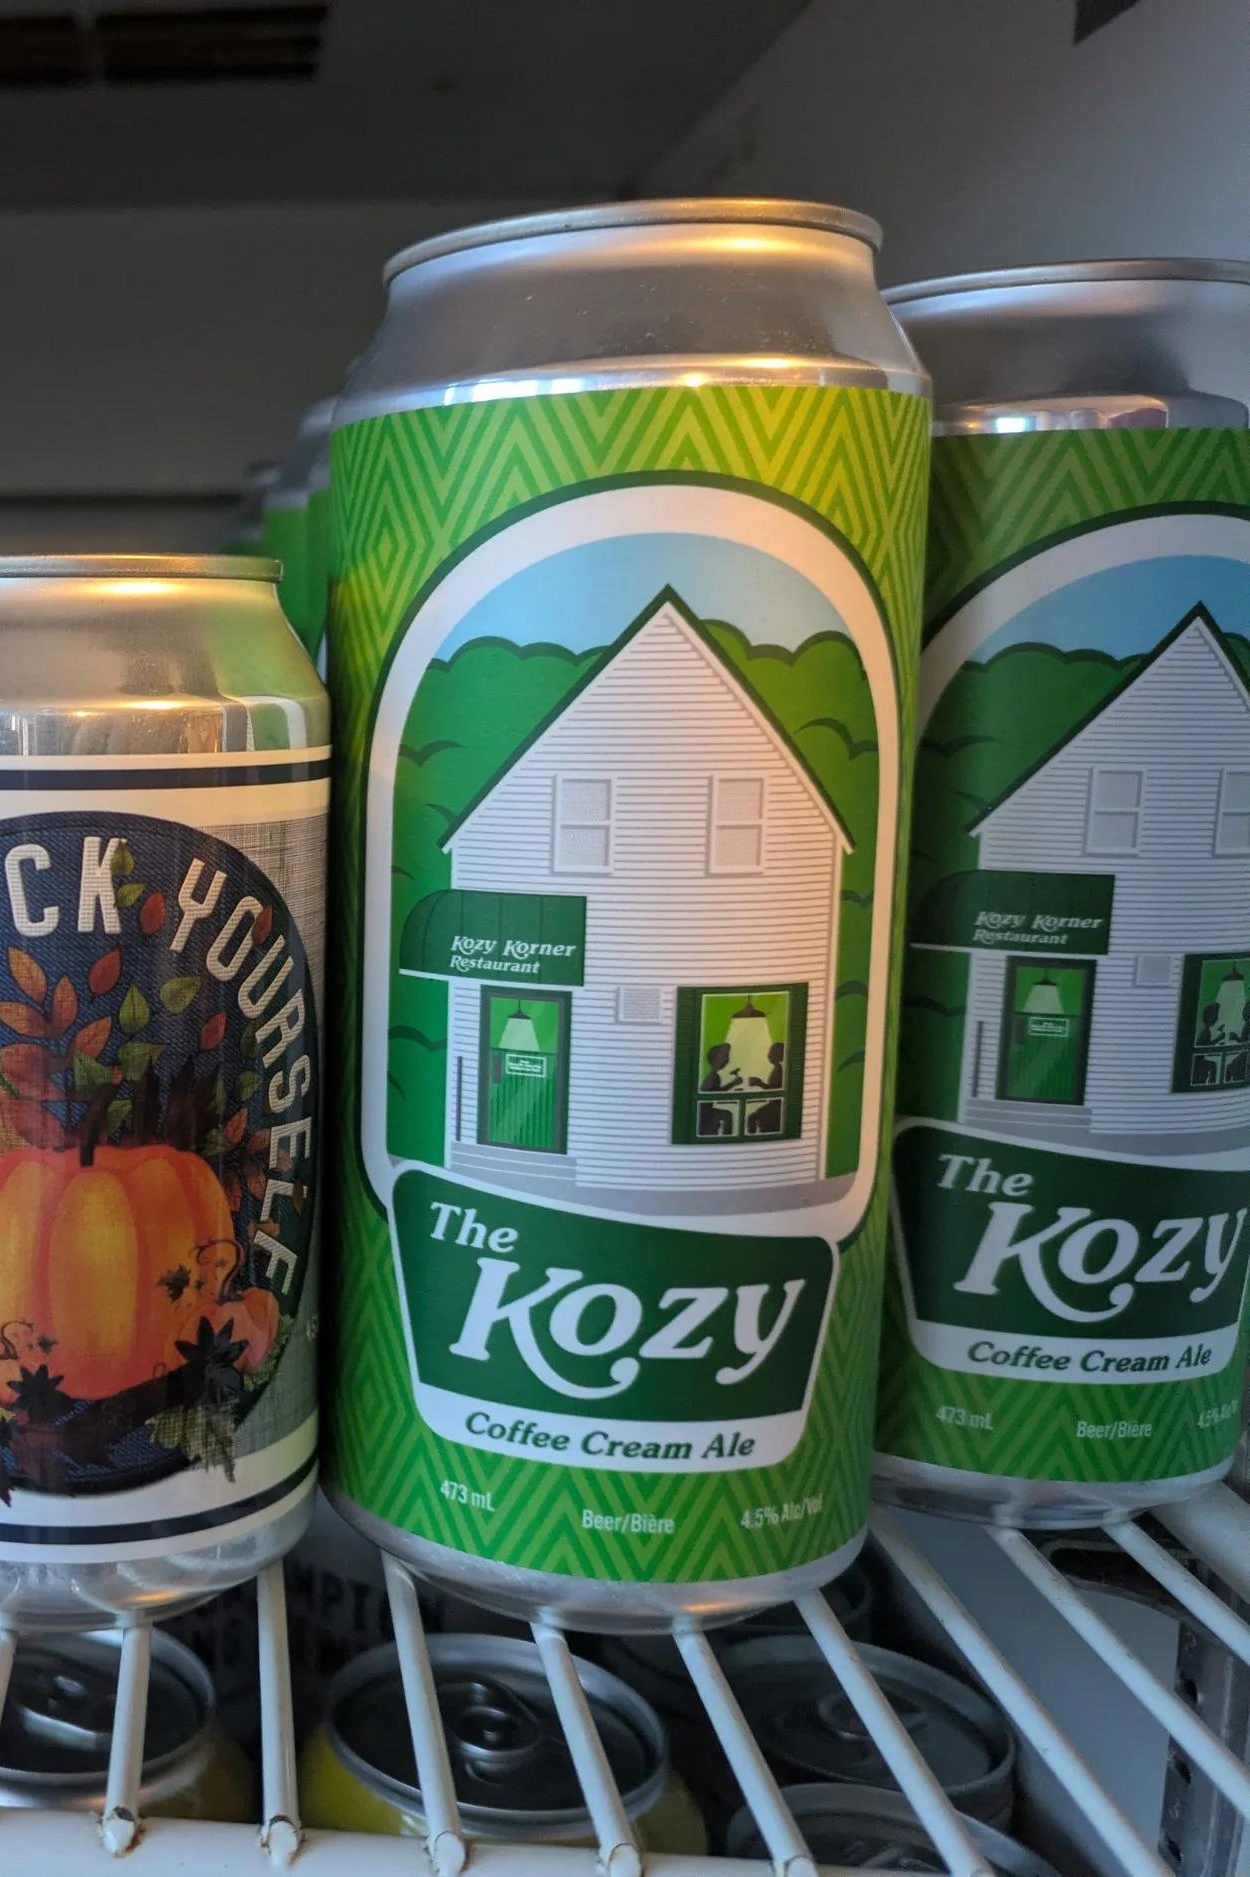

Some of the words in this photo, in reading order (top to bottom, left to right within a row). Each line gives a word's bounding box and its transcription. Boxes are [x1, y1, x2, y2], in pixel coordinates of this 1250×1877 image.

[972, 928, 1069, 945] Restaurant
[974, 911, 1026, 929] Kozy
[1031, 914, 1103, 932] Korner
[450, 955, 541, 974] Restaurant
[451, 935, 498, 956] Kozy
[502, 940, 578, 960] Korner
[170, 857, 314, 1296] YOURSELF
[937, 1153, 1034, 1198] The
[430, 1201, 519, 1253] The
[953, 1201, 1249, 1323] Kozy
[449, 1257, 806, 1400] Kozy
[967, 1340, 1070, 1372] Coffee
[1080, 1349, 1171, 1374] Cream
[1175, 1343, 1213, 1370] Ale
[465, 1411, 570, 1451] Coffee
[581, 1430, 691, 1461] Cream
[701, 1431, 756, 1460] Ale
[440, 1479, 468, 1504] 473
